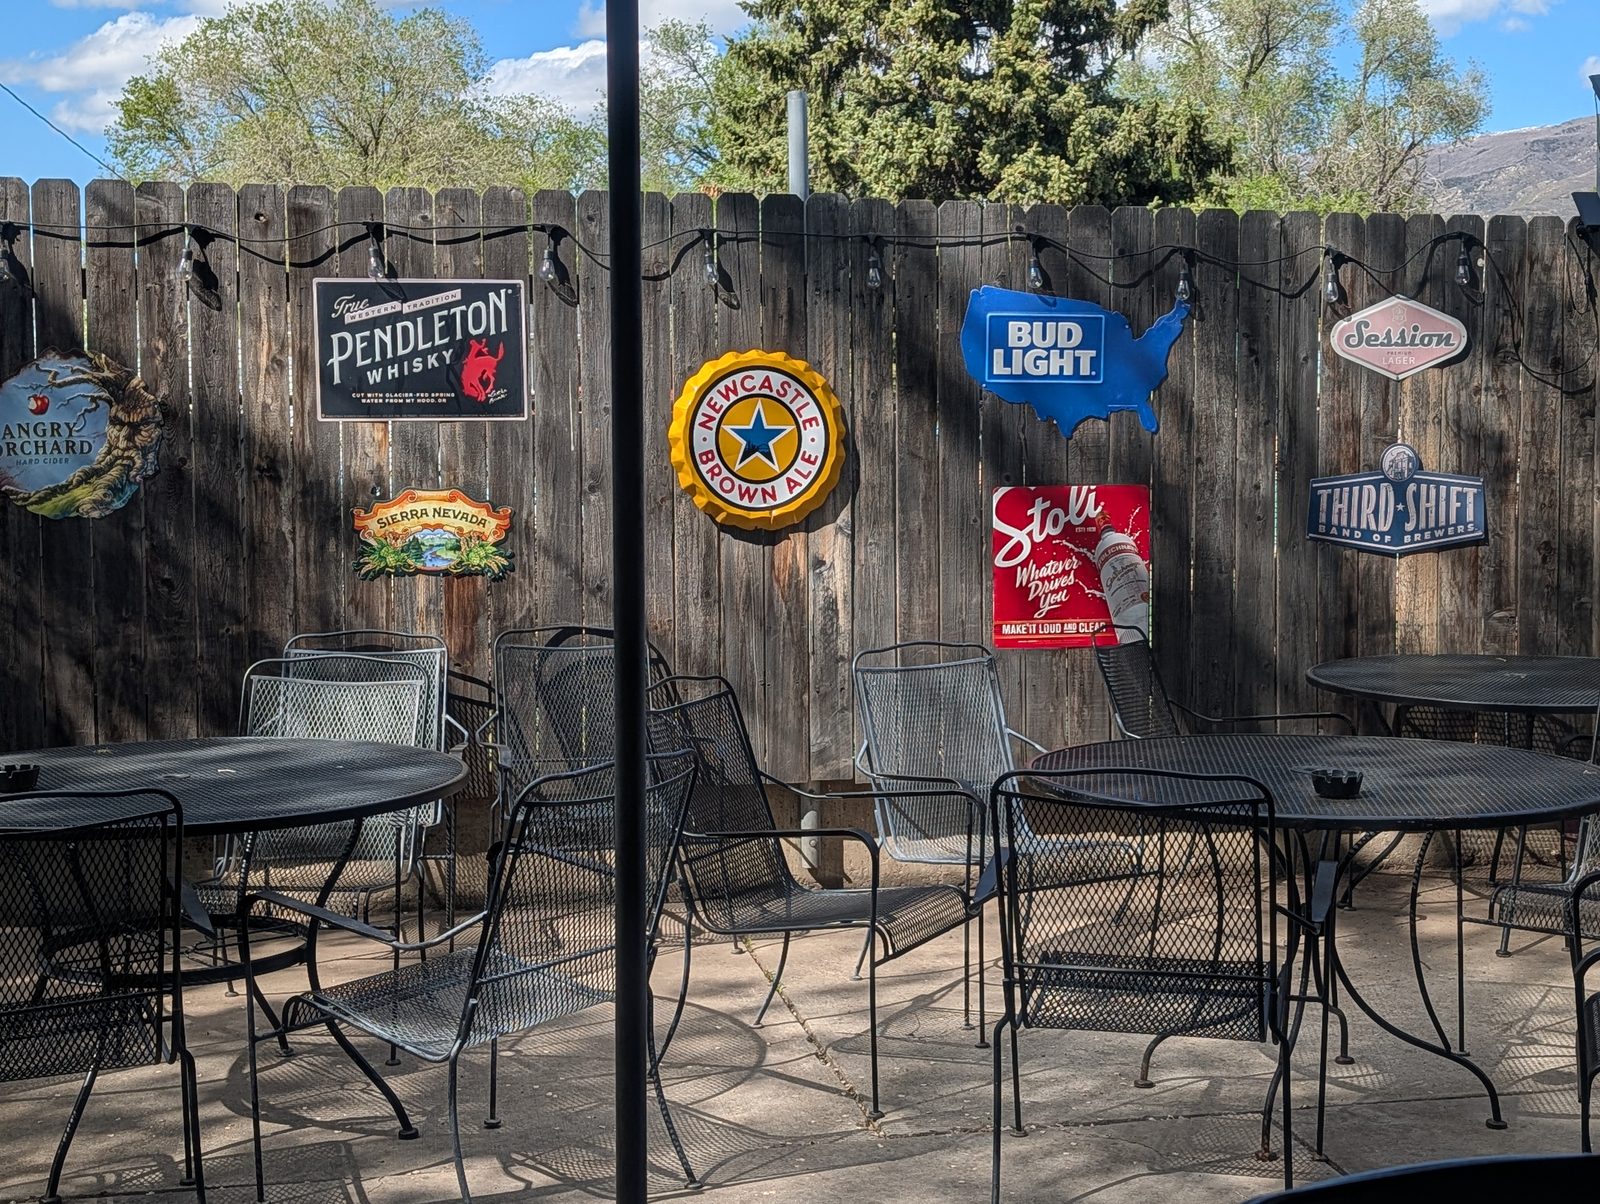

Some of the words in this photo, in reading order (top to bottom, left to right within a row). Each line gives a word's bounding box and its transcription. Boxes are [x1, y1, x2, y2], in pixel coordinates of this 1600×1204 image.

[331, 294, 370, 318] True
[349, 304, 397, 321] WESTERN
[406, 293, 458, 311] TRADITION
[326, 288, 508, 385] PENDLETON
[1007, 320, 1083, 348] BUD
[1343, 319, 1456, 349] Session
[366, 349, 454, 385] WHISKY
[1382, 356, 1416, 365] LAGER
[697, 374, 820, 432] NEWCASTLE
[1, 421, 78, 440] ANGRY
[0, 439, 93, 457] RCHARD
[15, 458, 40, 466] HARD
[43, 457, 70, 465] CIDER
[698, 449, 778, 504] BROWN
[785, 450, 819, 495] ALE
[376, 507, 429, 529] SIERRA
[432, 506, 488, 528] NEVADA
[1317, 482, 1395, 532] THIRD
[1404, 482, 1478, 532] SHIFT
[992, 485, 1103, 568] Stoli
[1318, 524, 1362, 539] BAND
[1372, 535, 1392, 544] OF
[1403, 523, 1475, 544] BREWERS
[1015, 555, 1081, 588] Whatever
[1027, 570, 1075, 601] Drives
[1002, 623, 1027, 635] MAKE
[1027, 623, 1036, 634] IT
[1038, 623, 1061, 634] LOUD
[1063, 622, 1077, 633] AND
